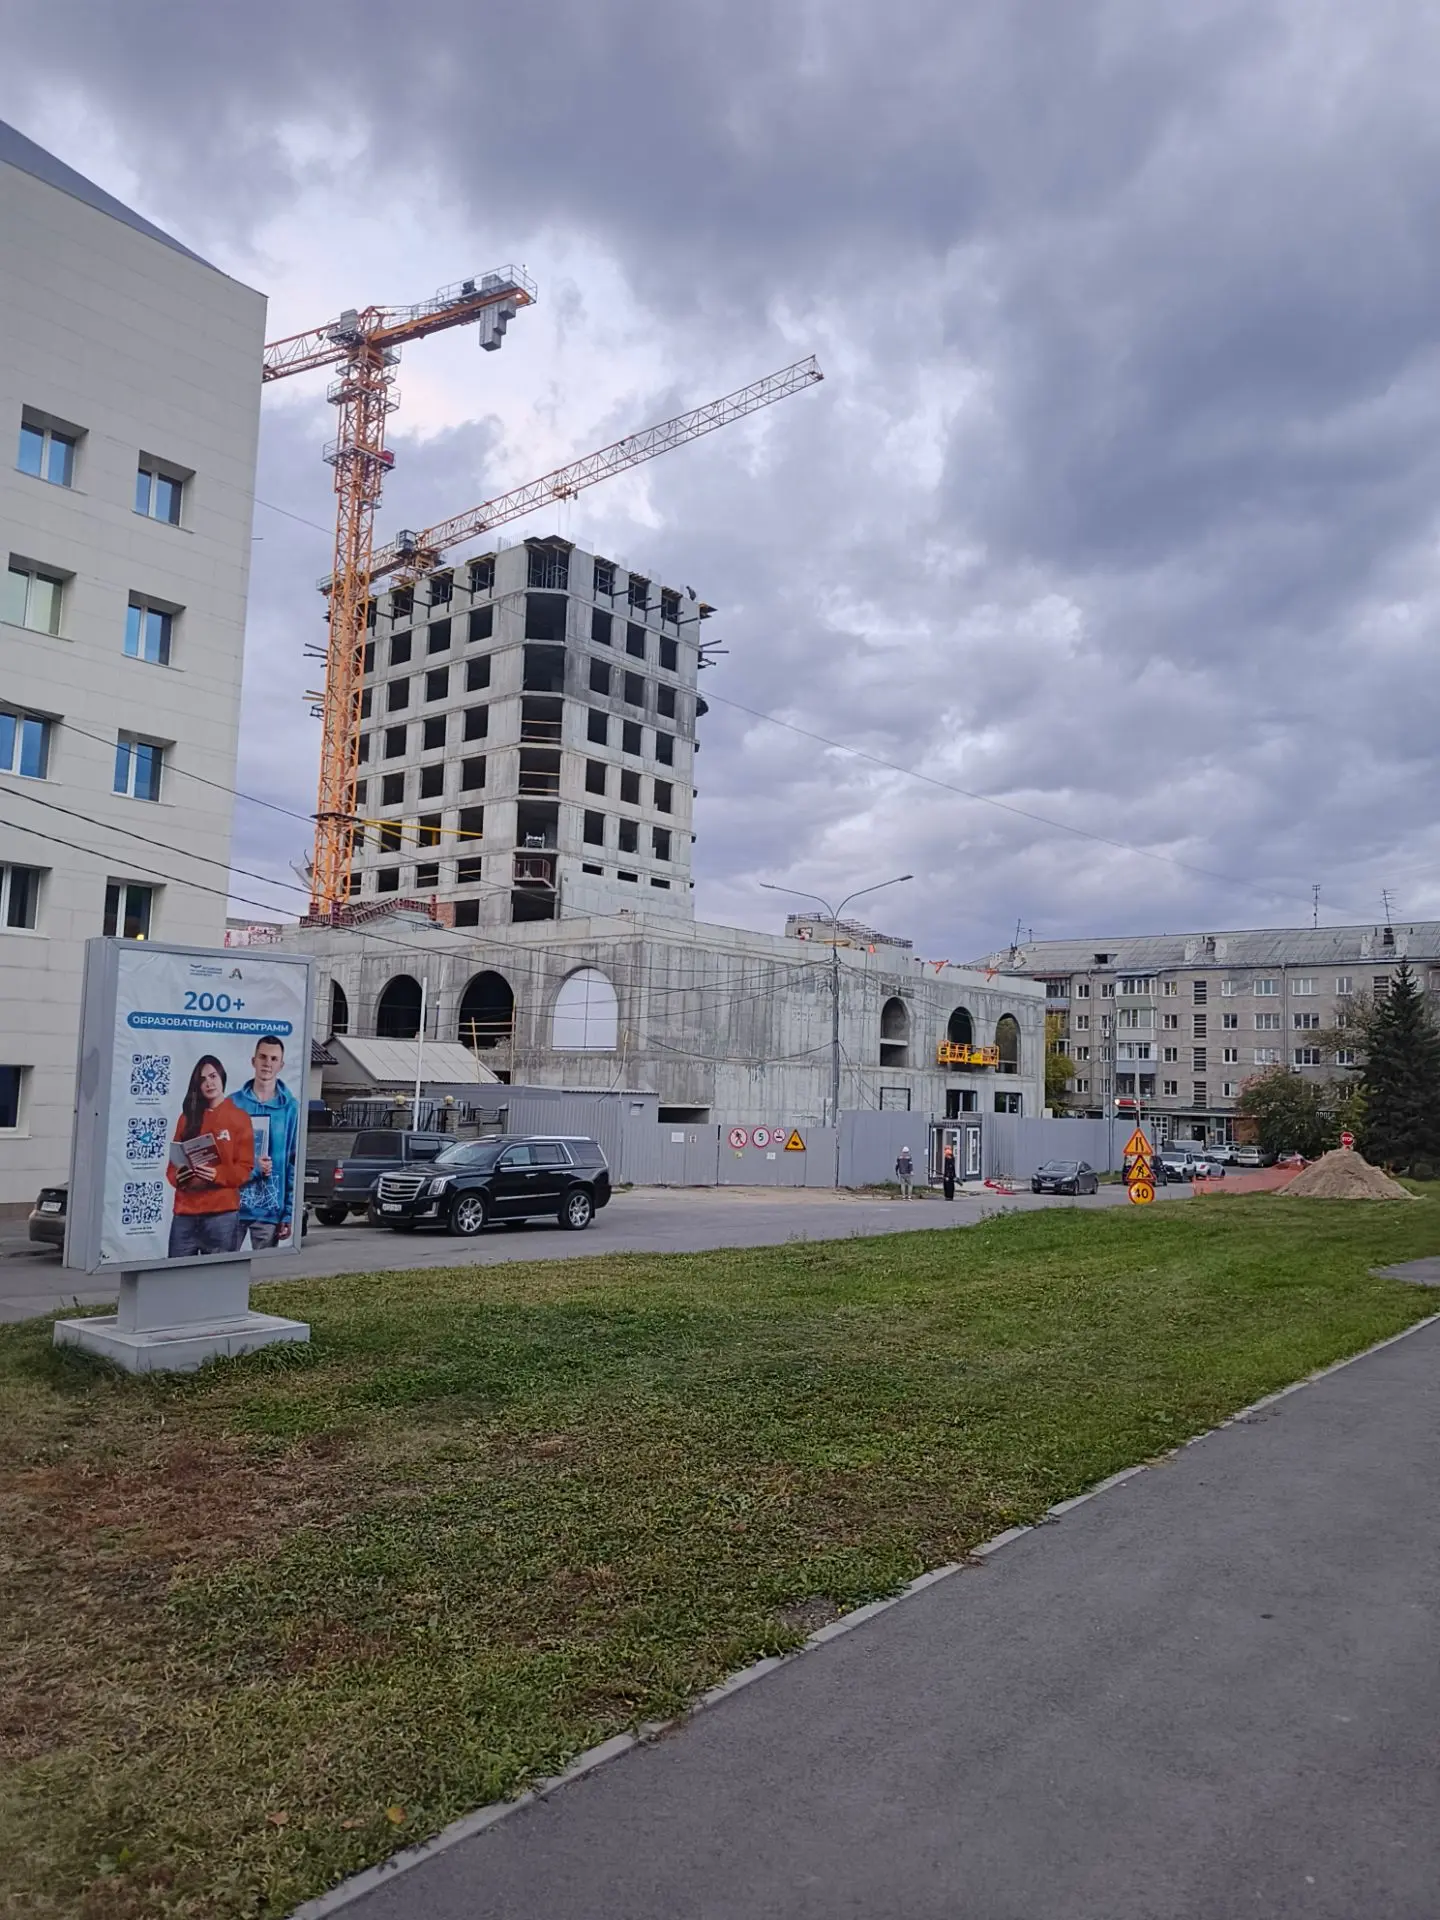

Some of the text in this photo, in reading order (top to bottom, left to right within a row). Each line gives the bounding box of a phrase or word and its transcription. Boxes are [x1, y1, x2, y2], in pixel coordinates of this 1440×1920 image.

[184, 991, 245, 1012] 200+
[132, 1016, 289, 1032] ОБРАЗОВАТЕЛЬНЫХ ПРОГРАММ
[758, 1133, 764, 1141] 5
[1135, 1188, 1148, 1198] 40
